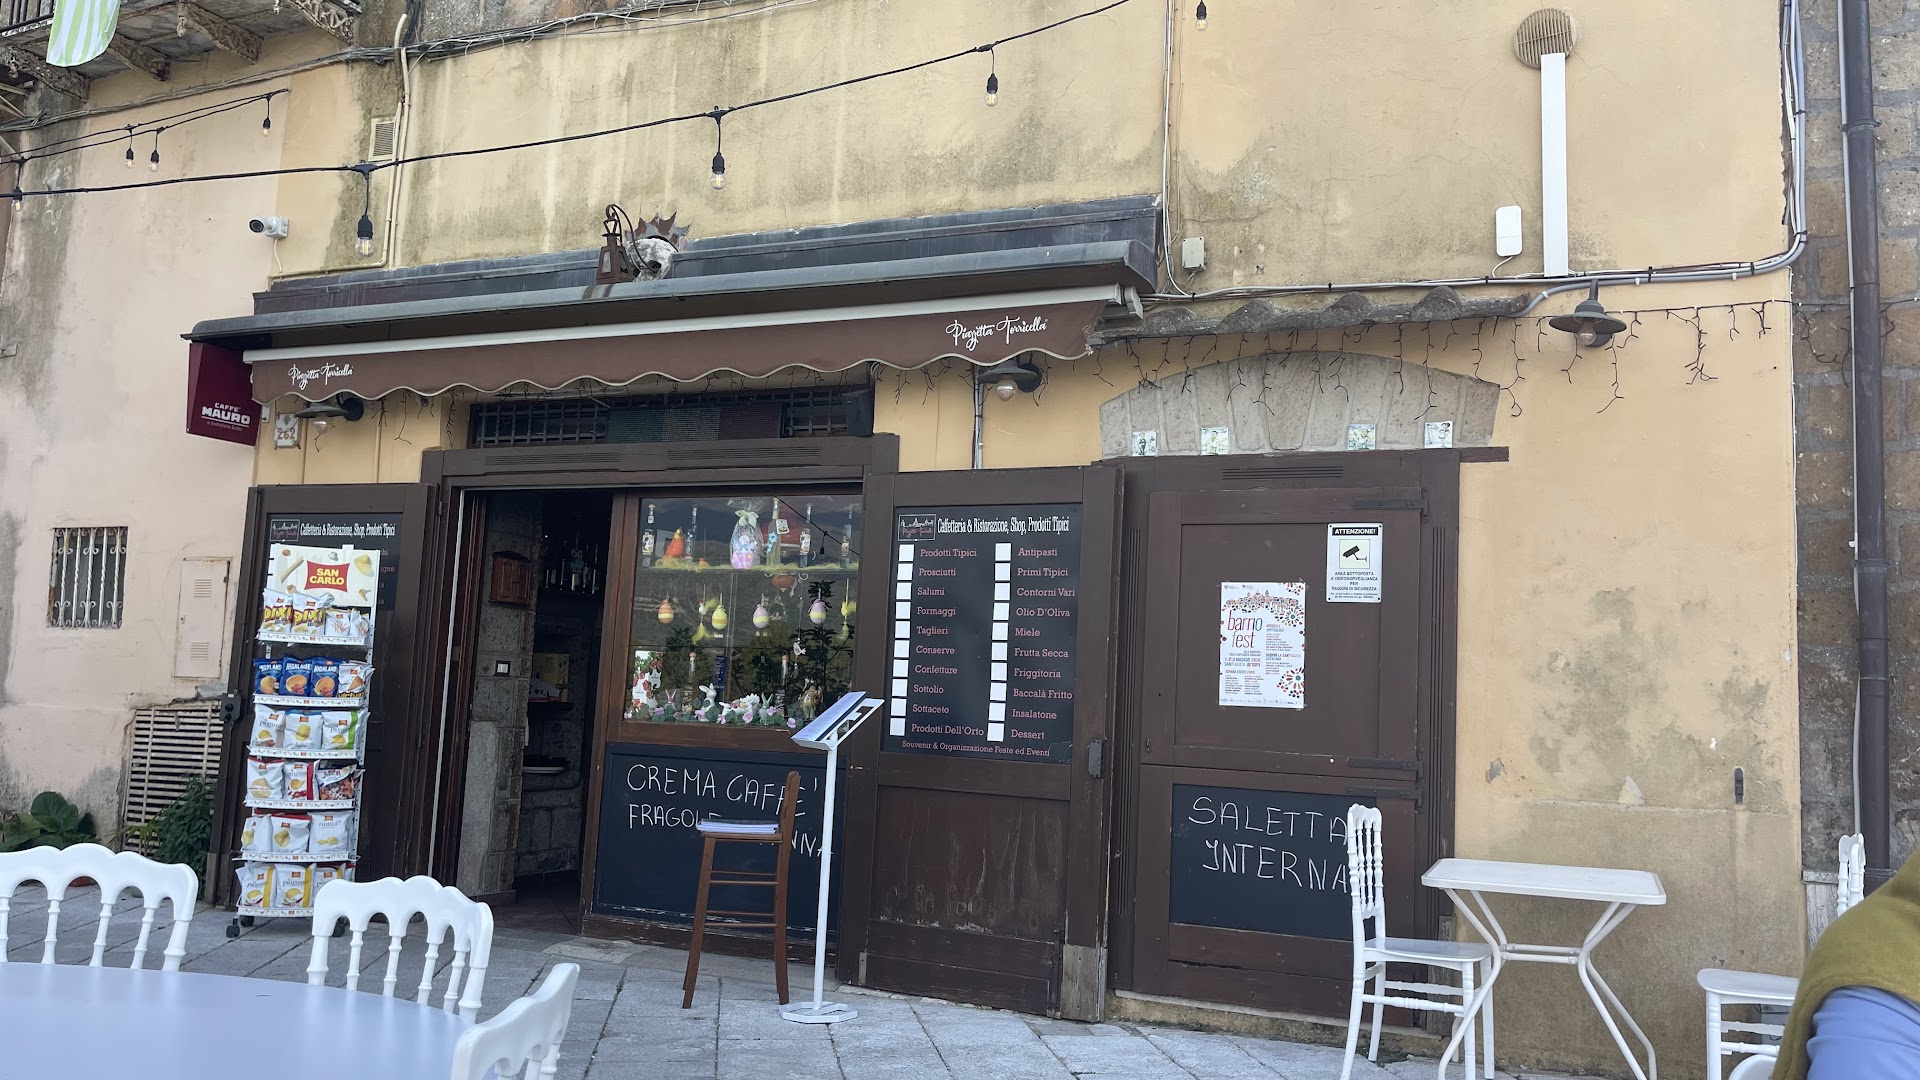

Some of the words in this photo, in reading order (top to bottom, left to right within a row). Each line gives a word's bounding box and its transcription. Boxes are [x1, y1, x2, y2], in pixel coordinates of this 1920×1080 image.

[946, 320, 995, 351] Piazzetta
[288, 364, 320, 390] Piazzetta
[202, 406, 250, 424] MAURO
[278, 428, 295, 439] 262
[322, 524, 326, 536] &
[938, 518, 966, 533] Caffetteria
[967, 518, 972, 532] &
[973, 517, 1009, 534] Ristorazione,
[1010, 517, 1027, 534] Shop,
[1028, 516, 1051, 532] Prodotti
[1052, 516, 1069, 534] Tipici
[920, 549, 951, 557] Prodotti
[953, 548, 976, 558] Tipici
[1018, 547, 1057, 557] Antipasti
[316, 568, 339, 576] SAN
[919, 568, 956, 577] Prosciutti
[1017, 568, 1041, 577] Primi
[1043, 568, 1068, 577] Tipici
[310, 576, 344, 585] CARLO
[918, 587, 944, 596] Salumi
[1017, 588, 1056, 596] Contorni
[1058, 588, 1075, 596] Vari
[264, 607, 292, 620] DIXI
[294, 608, 323, 622] DIXI
[917, 607, 956, 616] Formaggi
[1016, 608, 1035, 617] Olio
[1037, 608, 1070, 617] D'Oliva
[1228, 610, 1262, 631] barrio
[917, 626, 948, 636] Taglieri
[1015, 628, 1040, 637] Miele
[1232, 631, 1256, 648] fest
[916, 646, 955, 655] Conserve
[1014, 648, 1040, 657] Frutta
[1042, 649, 1068, 658] Secca
[915, 665, 957, 674] Confetture
[1014, 669, 1061, 679] Friggitoria
[914, 685, 944, 694] Sottolio
[1013, 688, 1046, 698] Baccalà
[1048, 690, 1072, 700] Fritto
[912, 704, 949, 713] Sottaceto
[1012, 710, 1057, 719] Insalatone
[912, 724, 942, 734] Prodotti
[945, 726, 984, 736] Dell'Orto
[1011, 730, 1045, 739] Dessert
[940, 742, 993, 753] Organizzazione
[995, 745, 1014, 754] Feste
[1015, 747, 1025, 755] ed
[1027, 747, 1050, 757] Eventi
[627, 764, 716, 799] CREMA
[1188, 796, 1348, 846] SALETTA
